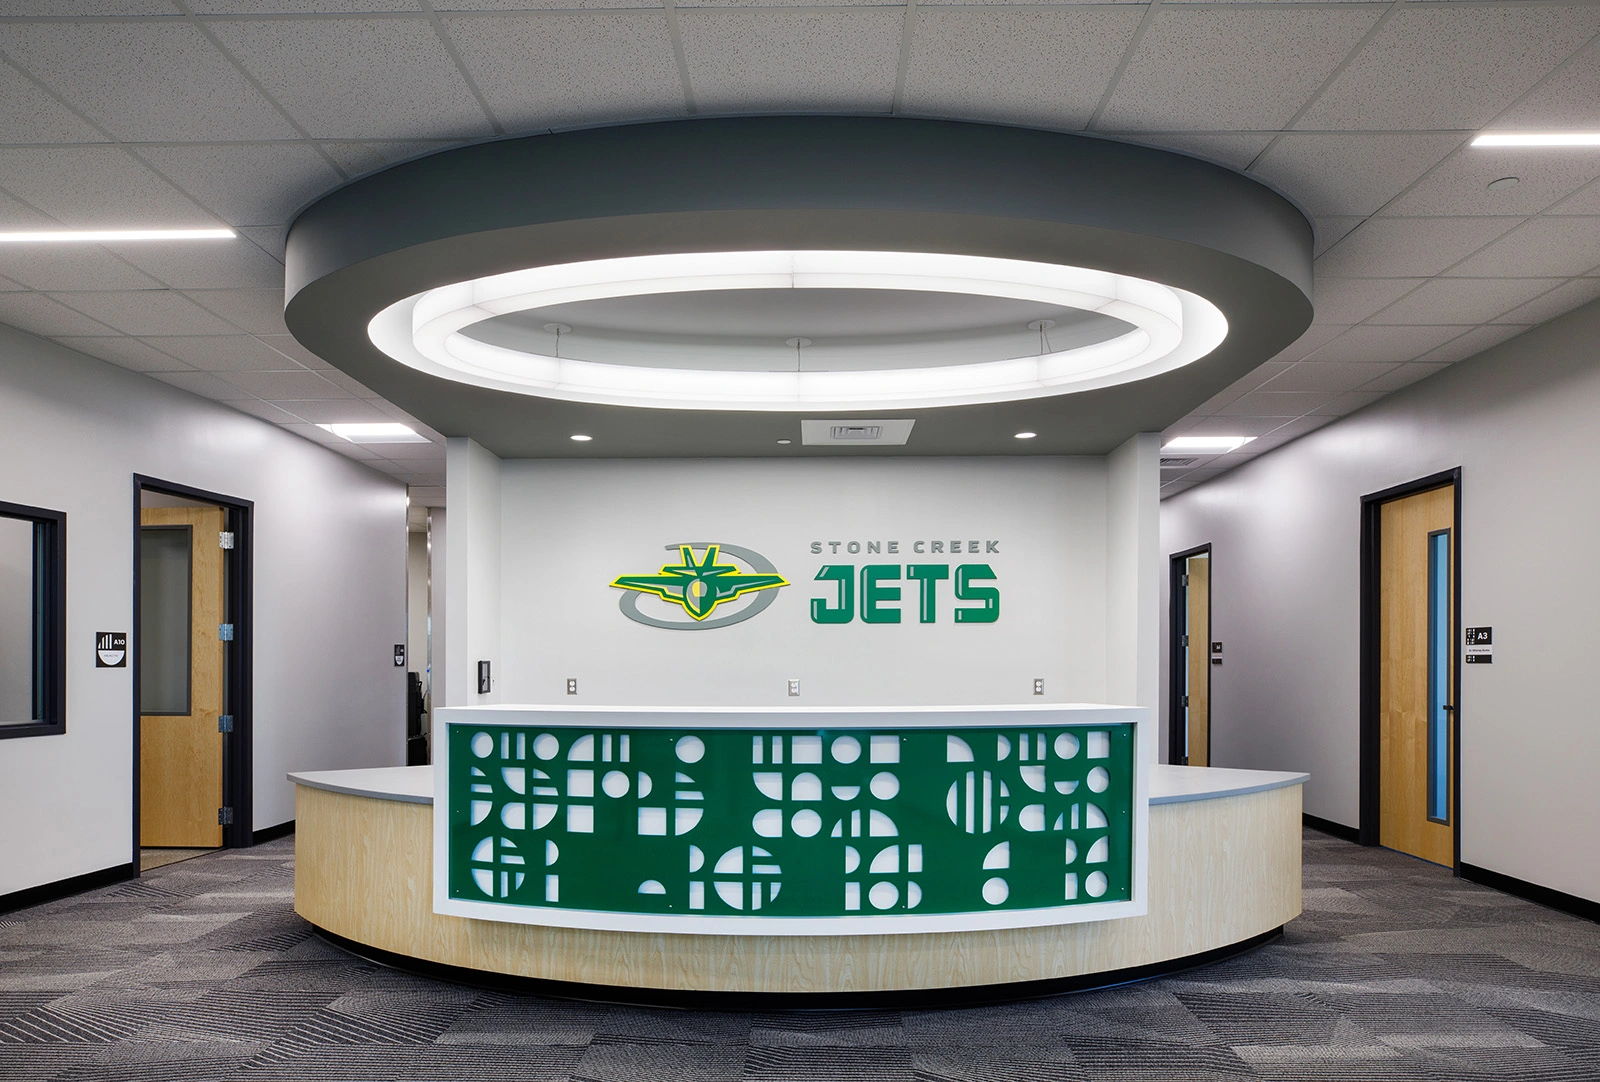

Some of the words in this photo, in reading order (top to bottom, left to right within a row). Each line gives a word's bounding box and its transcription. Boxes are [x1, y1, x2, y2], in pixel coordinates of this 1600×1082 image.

[810, 540, 899, 555] STONE
[913, 540, 1000, 554] CREEK
[810, 564, 1000, 624] JETS
